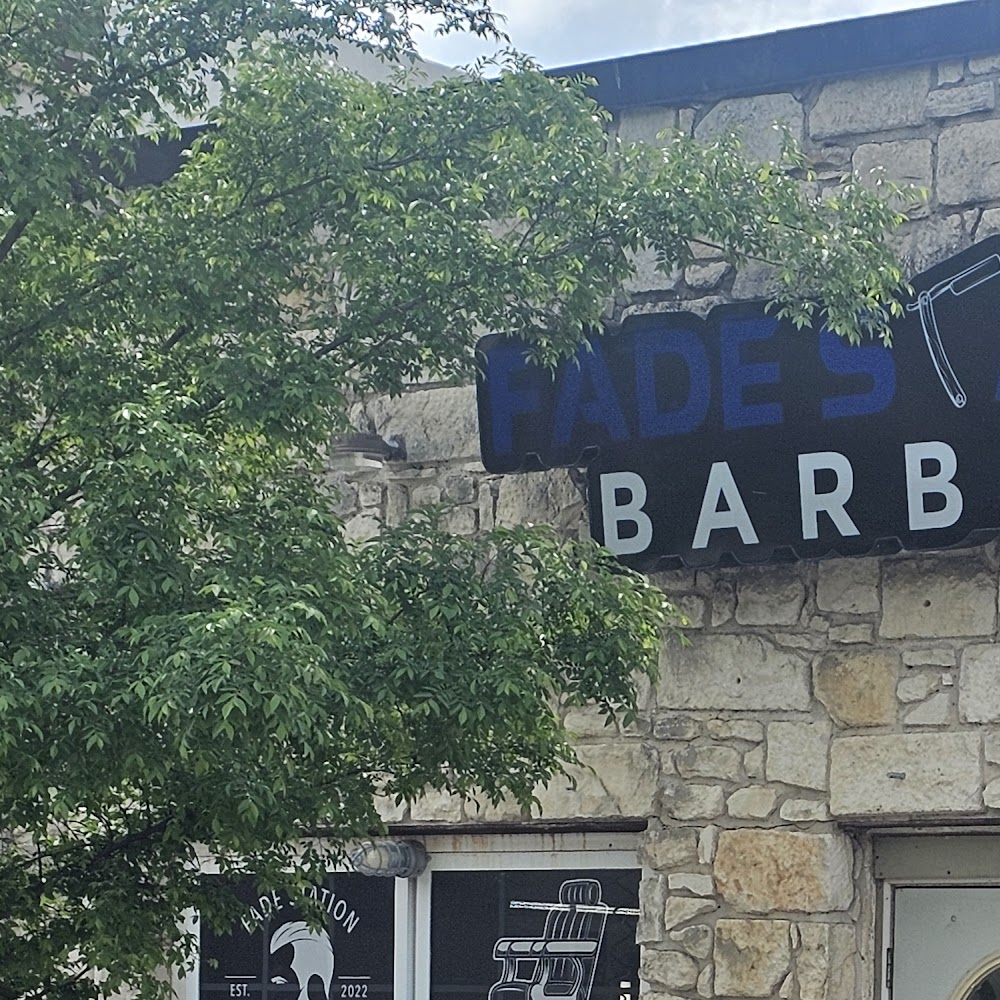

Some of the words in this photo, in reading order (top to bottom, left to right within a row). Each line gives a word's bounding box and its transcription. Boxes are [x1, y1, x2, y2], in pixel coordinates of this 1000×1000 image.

[488, 316, 784, 458] FADE
[229, 984, 251, 998] EST.
[340, 984, 369, 999] 2022
